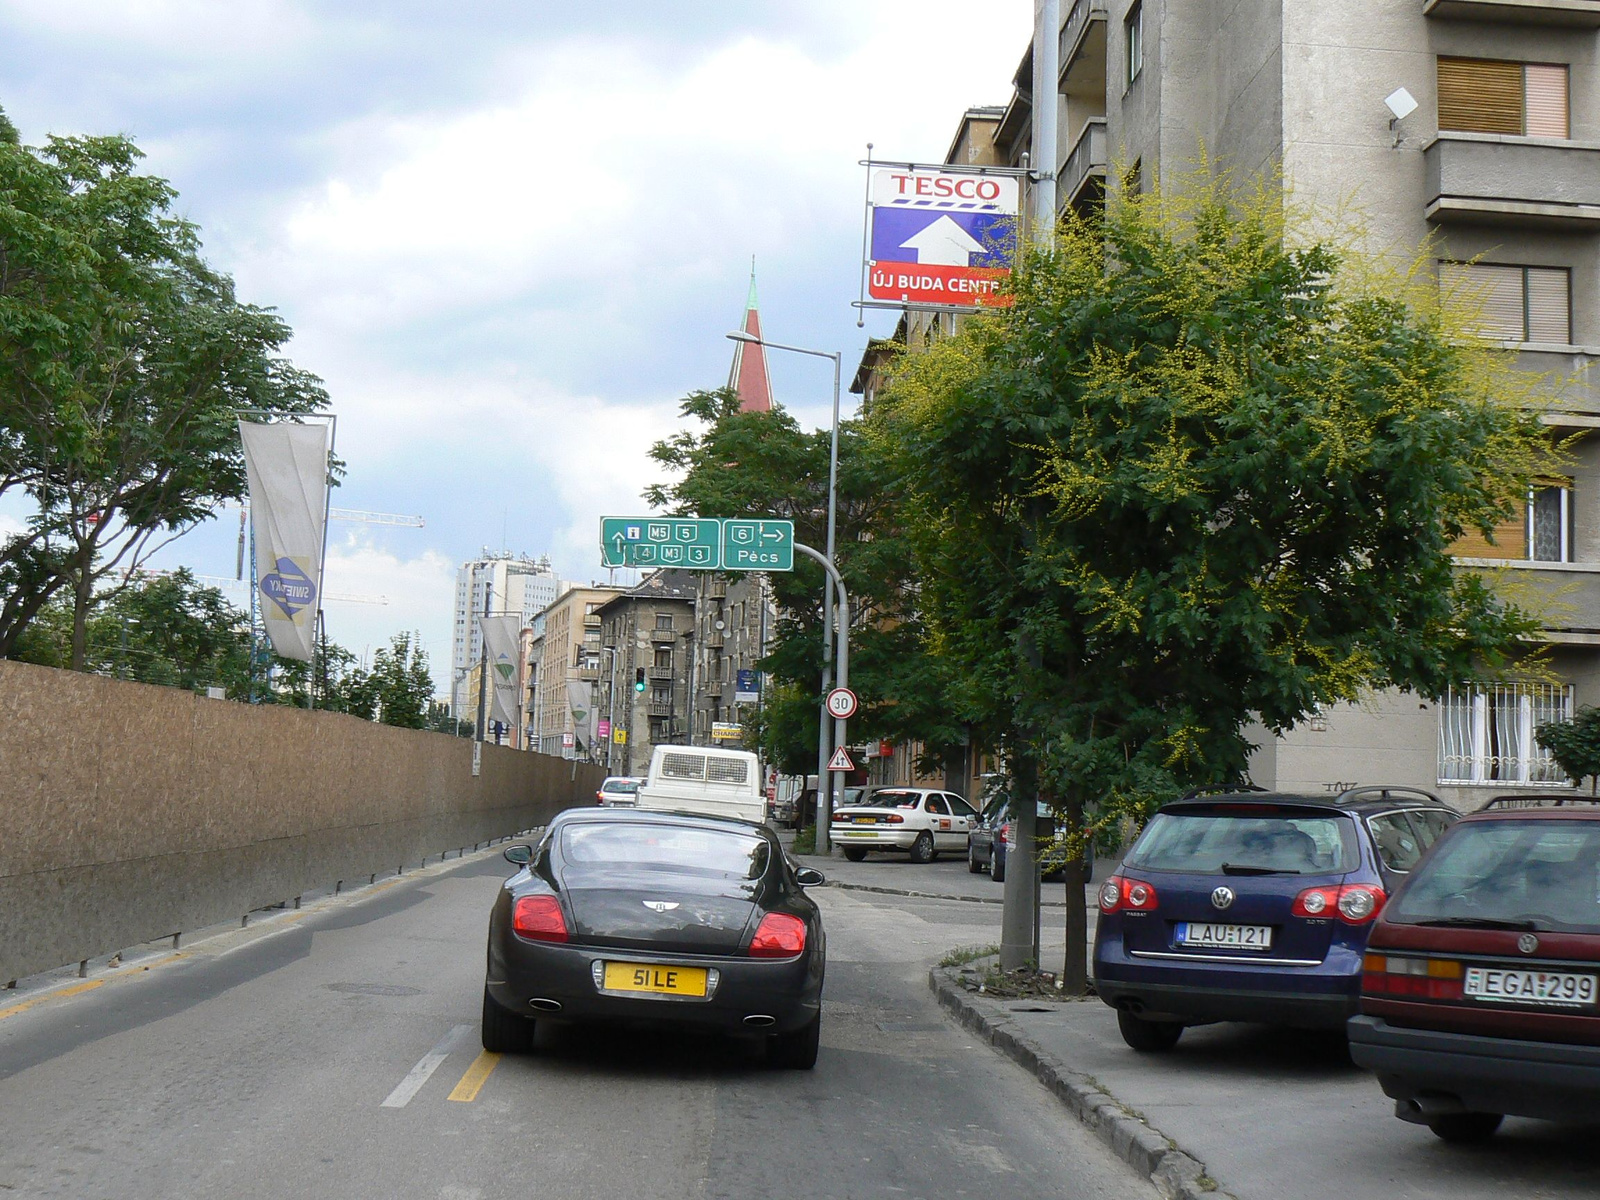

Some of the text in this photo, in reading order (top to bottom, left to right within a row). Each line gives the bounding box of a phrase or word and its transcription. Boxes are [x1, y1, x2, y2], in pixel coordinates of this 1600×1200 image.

[891, 175, 1000, 200] TESCO
[873, 270, 894, 288] ÚJ
[898, 275, 944, 291] BUDA
[651, 527, 667, 538] M5
[682, 528, 690, 539] 5
[738, 529, 748, 540] 6
[641, 547, 703, 560] 4 M3 3
[738, 550, 779, 563] Pécs
[834, 697, 849, 710] 30
[1188, 924, 1266, 945] LAU-121
[1485, 970, 1592, 1000] EGA-299
